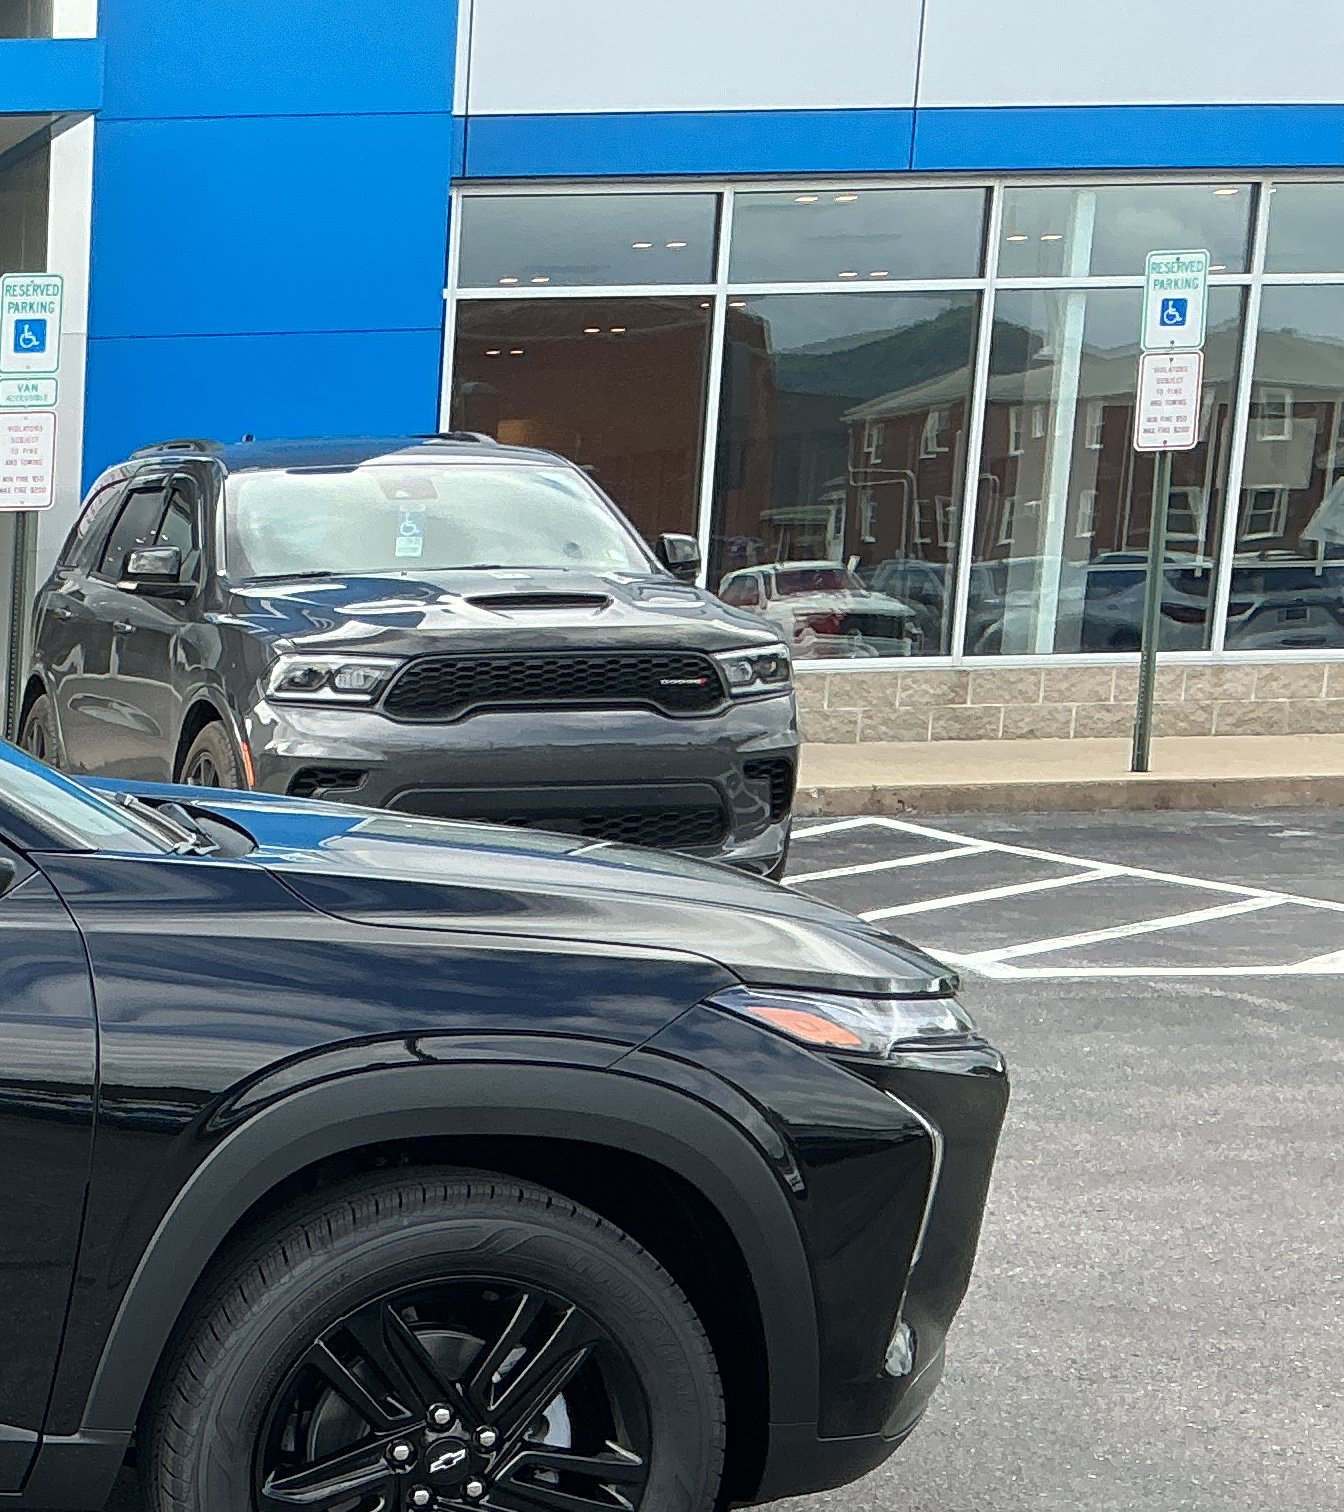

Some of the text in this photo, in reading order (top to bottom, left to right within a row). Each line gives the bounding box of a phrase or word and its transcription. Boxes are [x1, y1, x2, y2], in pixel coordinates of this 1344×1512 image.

[1150, 260, 1204, 274] RESERVED
[1153, 277, 1199, 290] PARKING
[5, 284, 60, 297] RESERVED
[7, 301, 56, 314] PARKING
[17, 383, 39, 393] VAN
